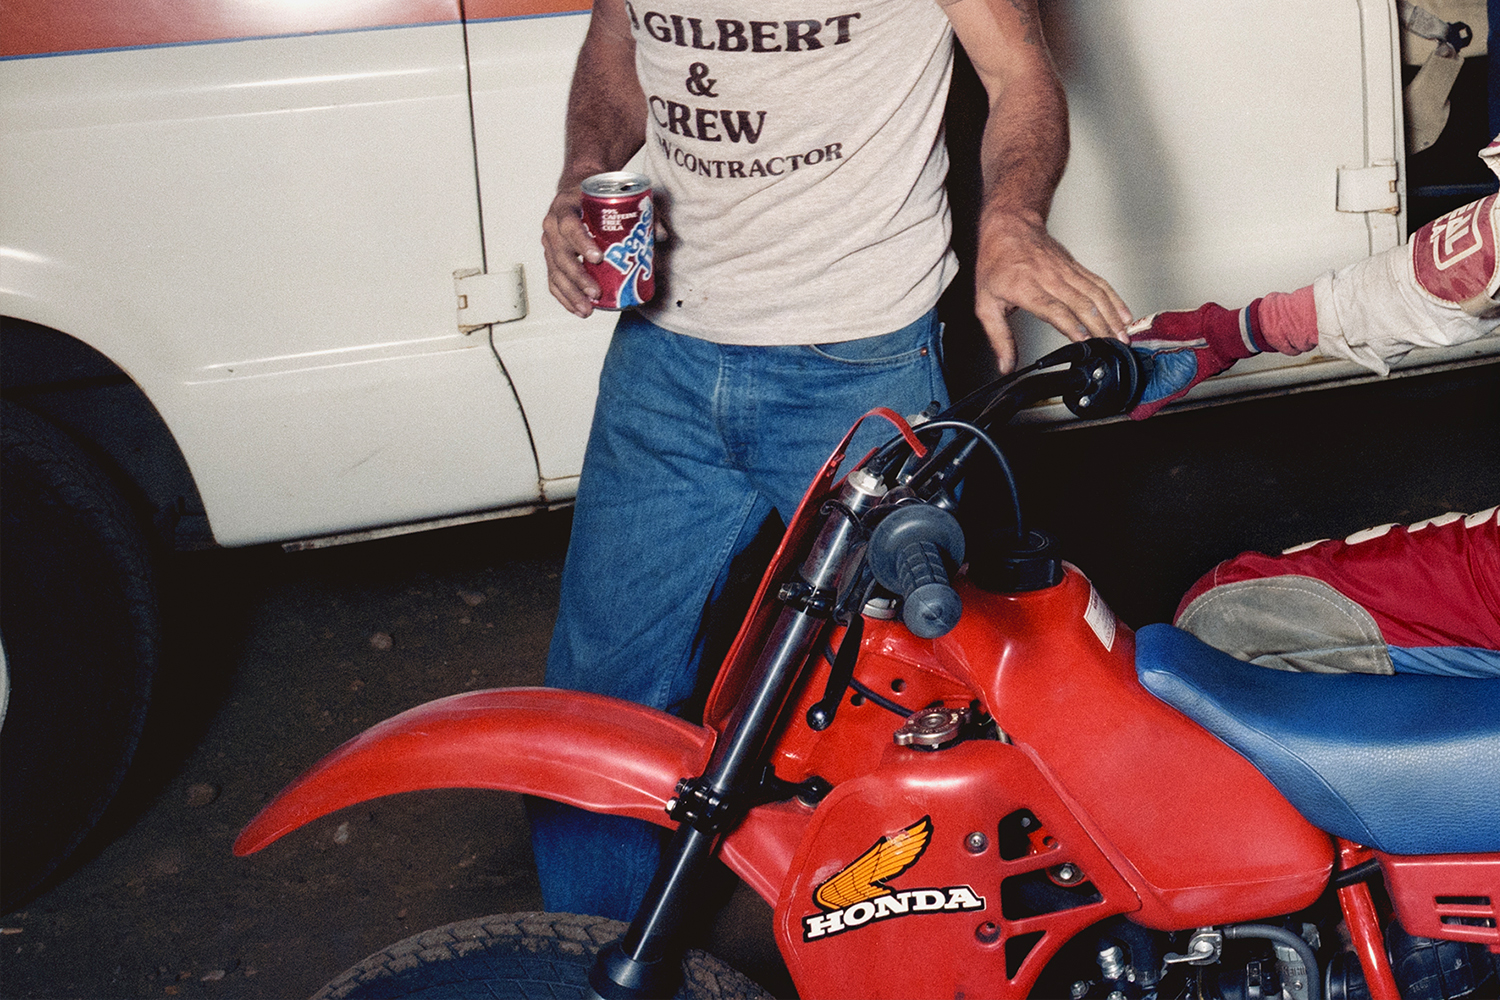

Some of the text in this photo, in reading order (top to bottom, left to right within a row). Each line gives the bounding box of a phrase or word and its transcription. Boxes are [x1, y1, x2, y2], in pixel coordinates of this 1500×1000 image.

[644, 11, 861, 53] GILBERT
[685, 62, 719, 98] &
[649, 95, 767, 144] CREW
[674, 142, 843, 179] CONTRACTOR
[601, 212, 638, 221] CAFFEINE
[806, 888, 982, 938] HONDA
